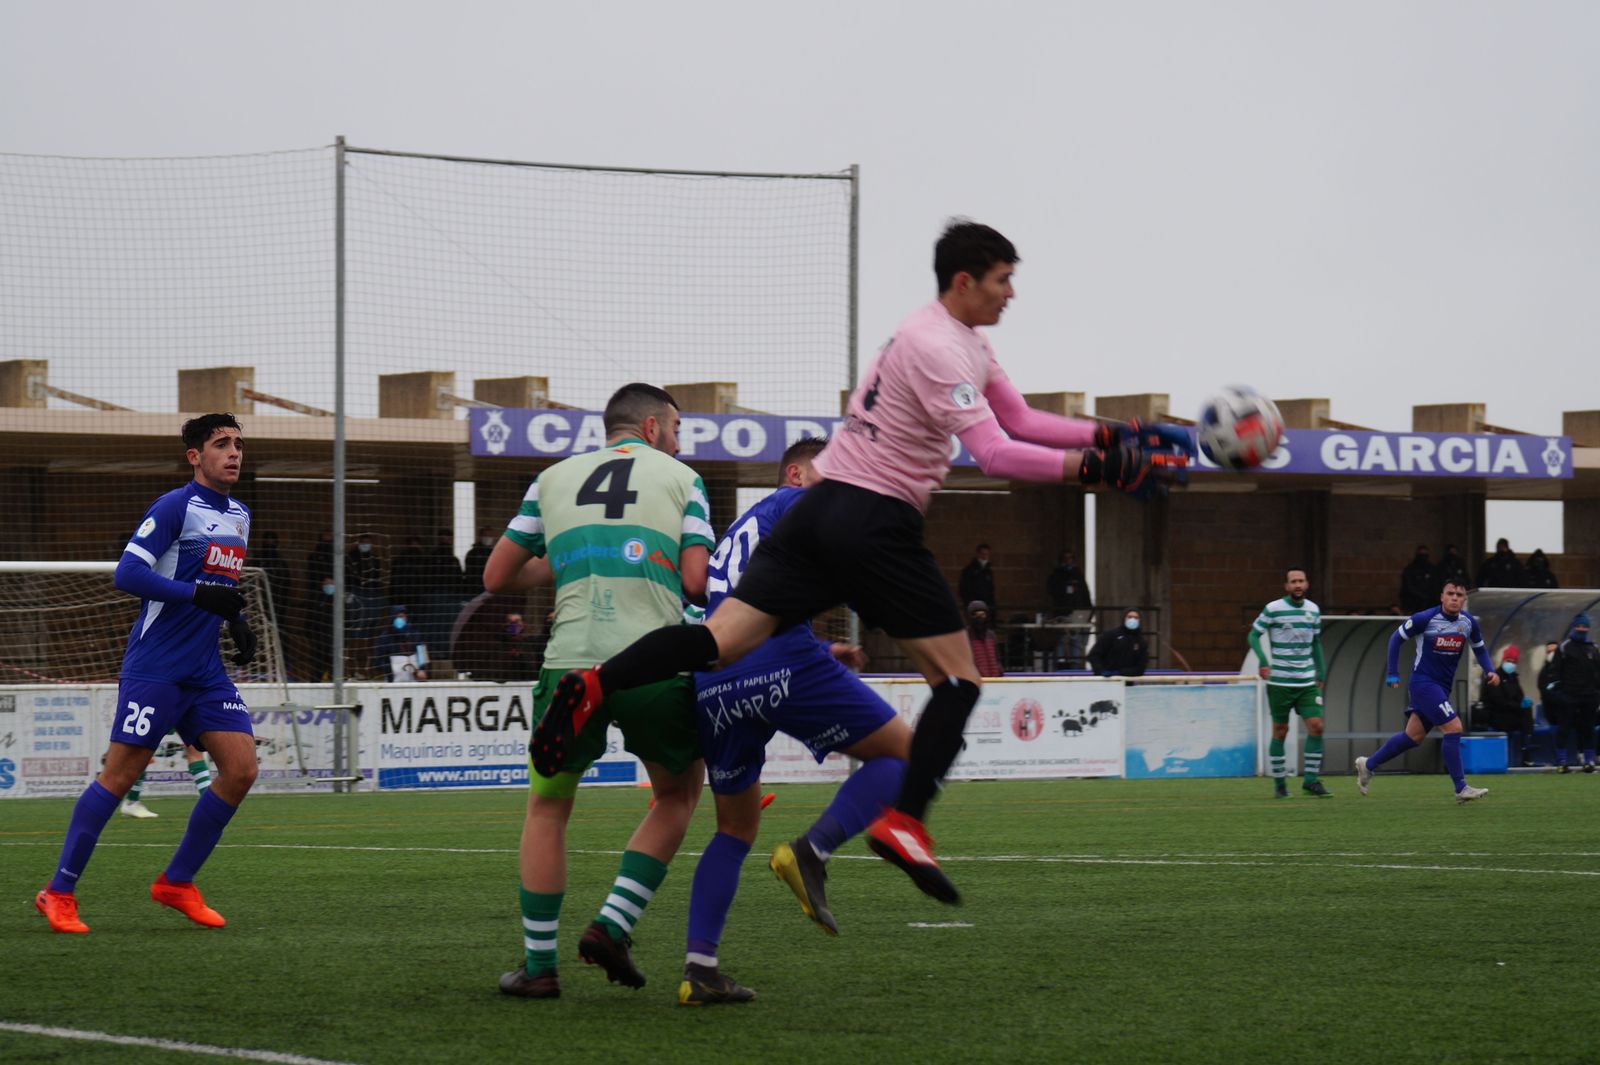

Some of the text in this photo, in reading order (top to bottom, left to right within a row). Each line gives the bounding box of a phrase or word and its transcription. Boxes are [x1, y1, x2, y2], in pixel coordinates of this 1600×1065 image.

[527, 412, 767, 457] CAPO
[1320, 434, 1529, 474] GARCIA
[575, 457, 638, 519] 4
[122, 701, 155, 736] 26
[1438, 701, 1455, 718] 14
[381, 743, 463, 762] Maquinaria
